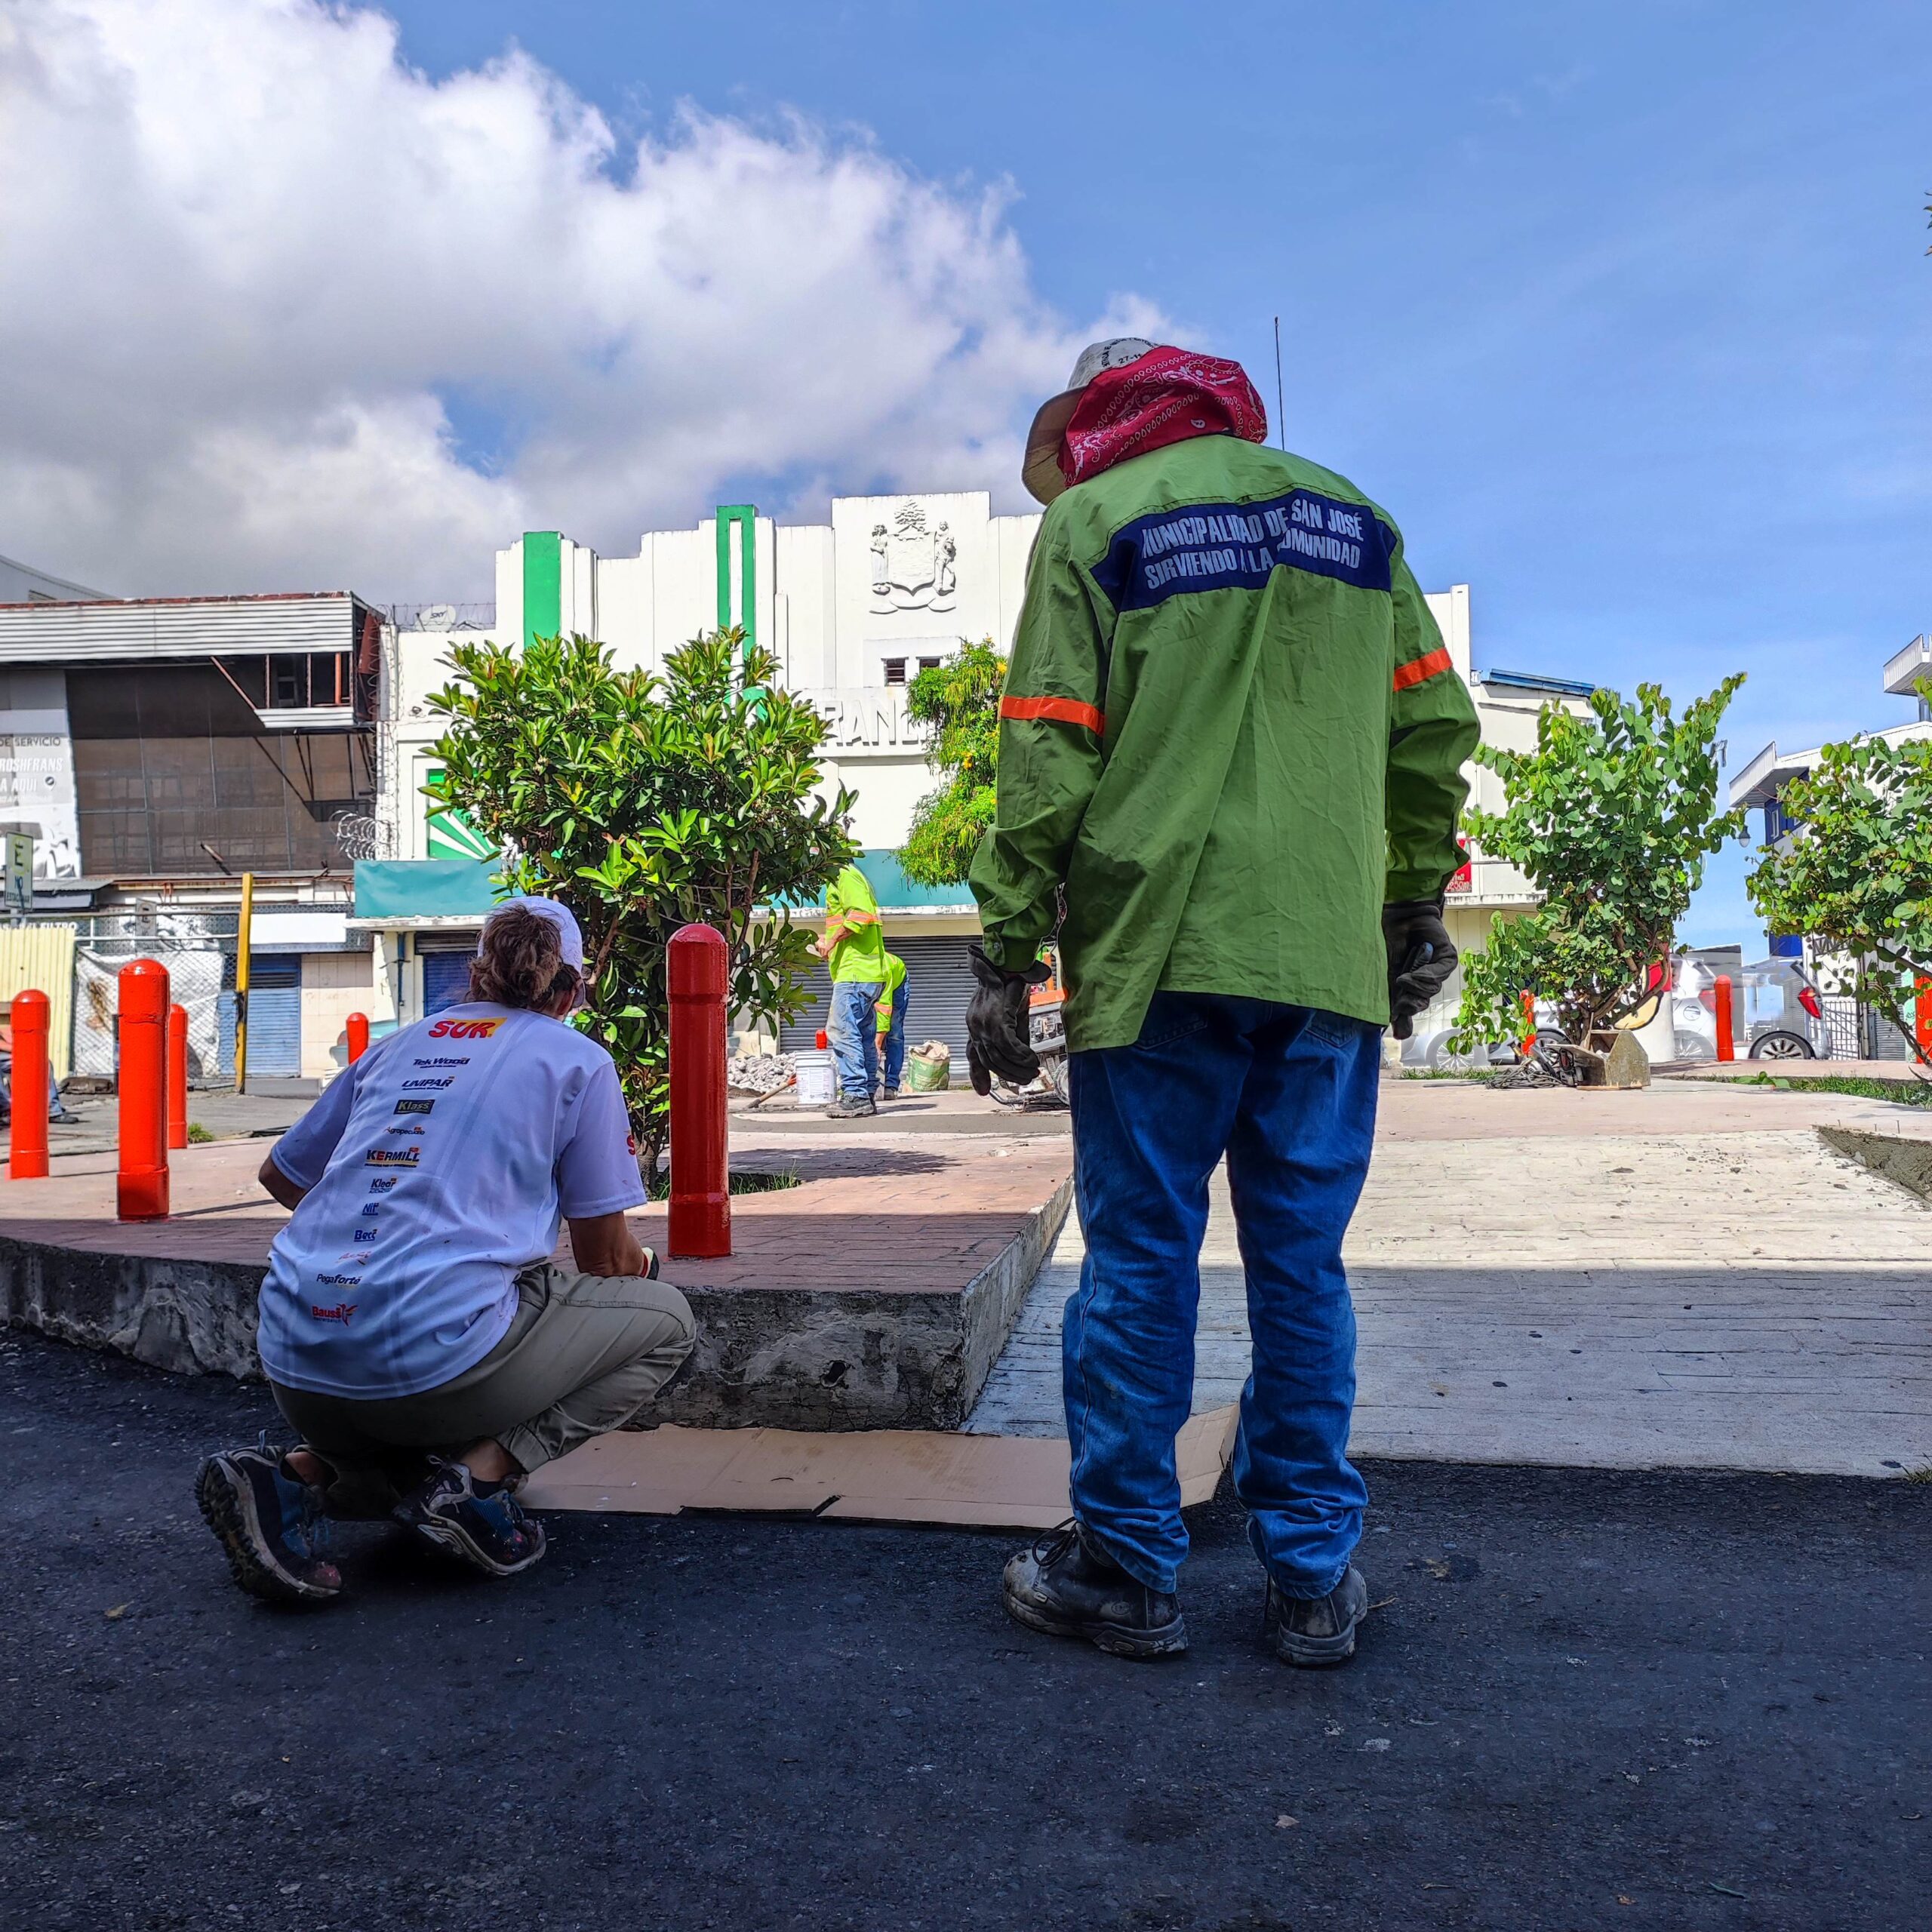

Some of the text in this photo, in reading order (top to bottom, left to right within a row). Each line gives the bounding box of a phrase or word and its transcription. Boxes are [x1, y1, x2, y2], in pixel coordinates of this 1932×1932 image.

[1291, 499, 1323, 528] SAN
[1327, 509, 1364, 542] JOSÉ
[1144, 549, 1238, 589] SIRVIENDO
[1247, 547, 1275, 573] LA
[15, 737, 61, 746] SERVICIO
[429, 1020, 495, 1038] SUR
[401, 1078, 453, 1088] UNIPAR
[398, 1101, 430, 1110] Klass
